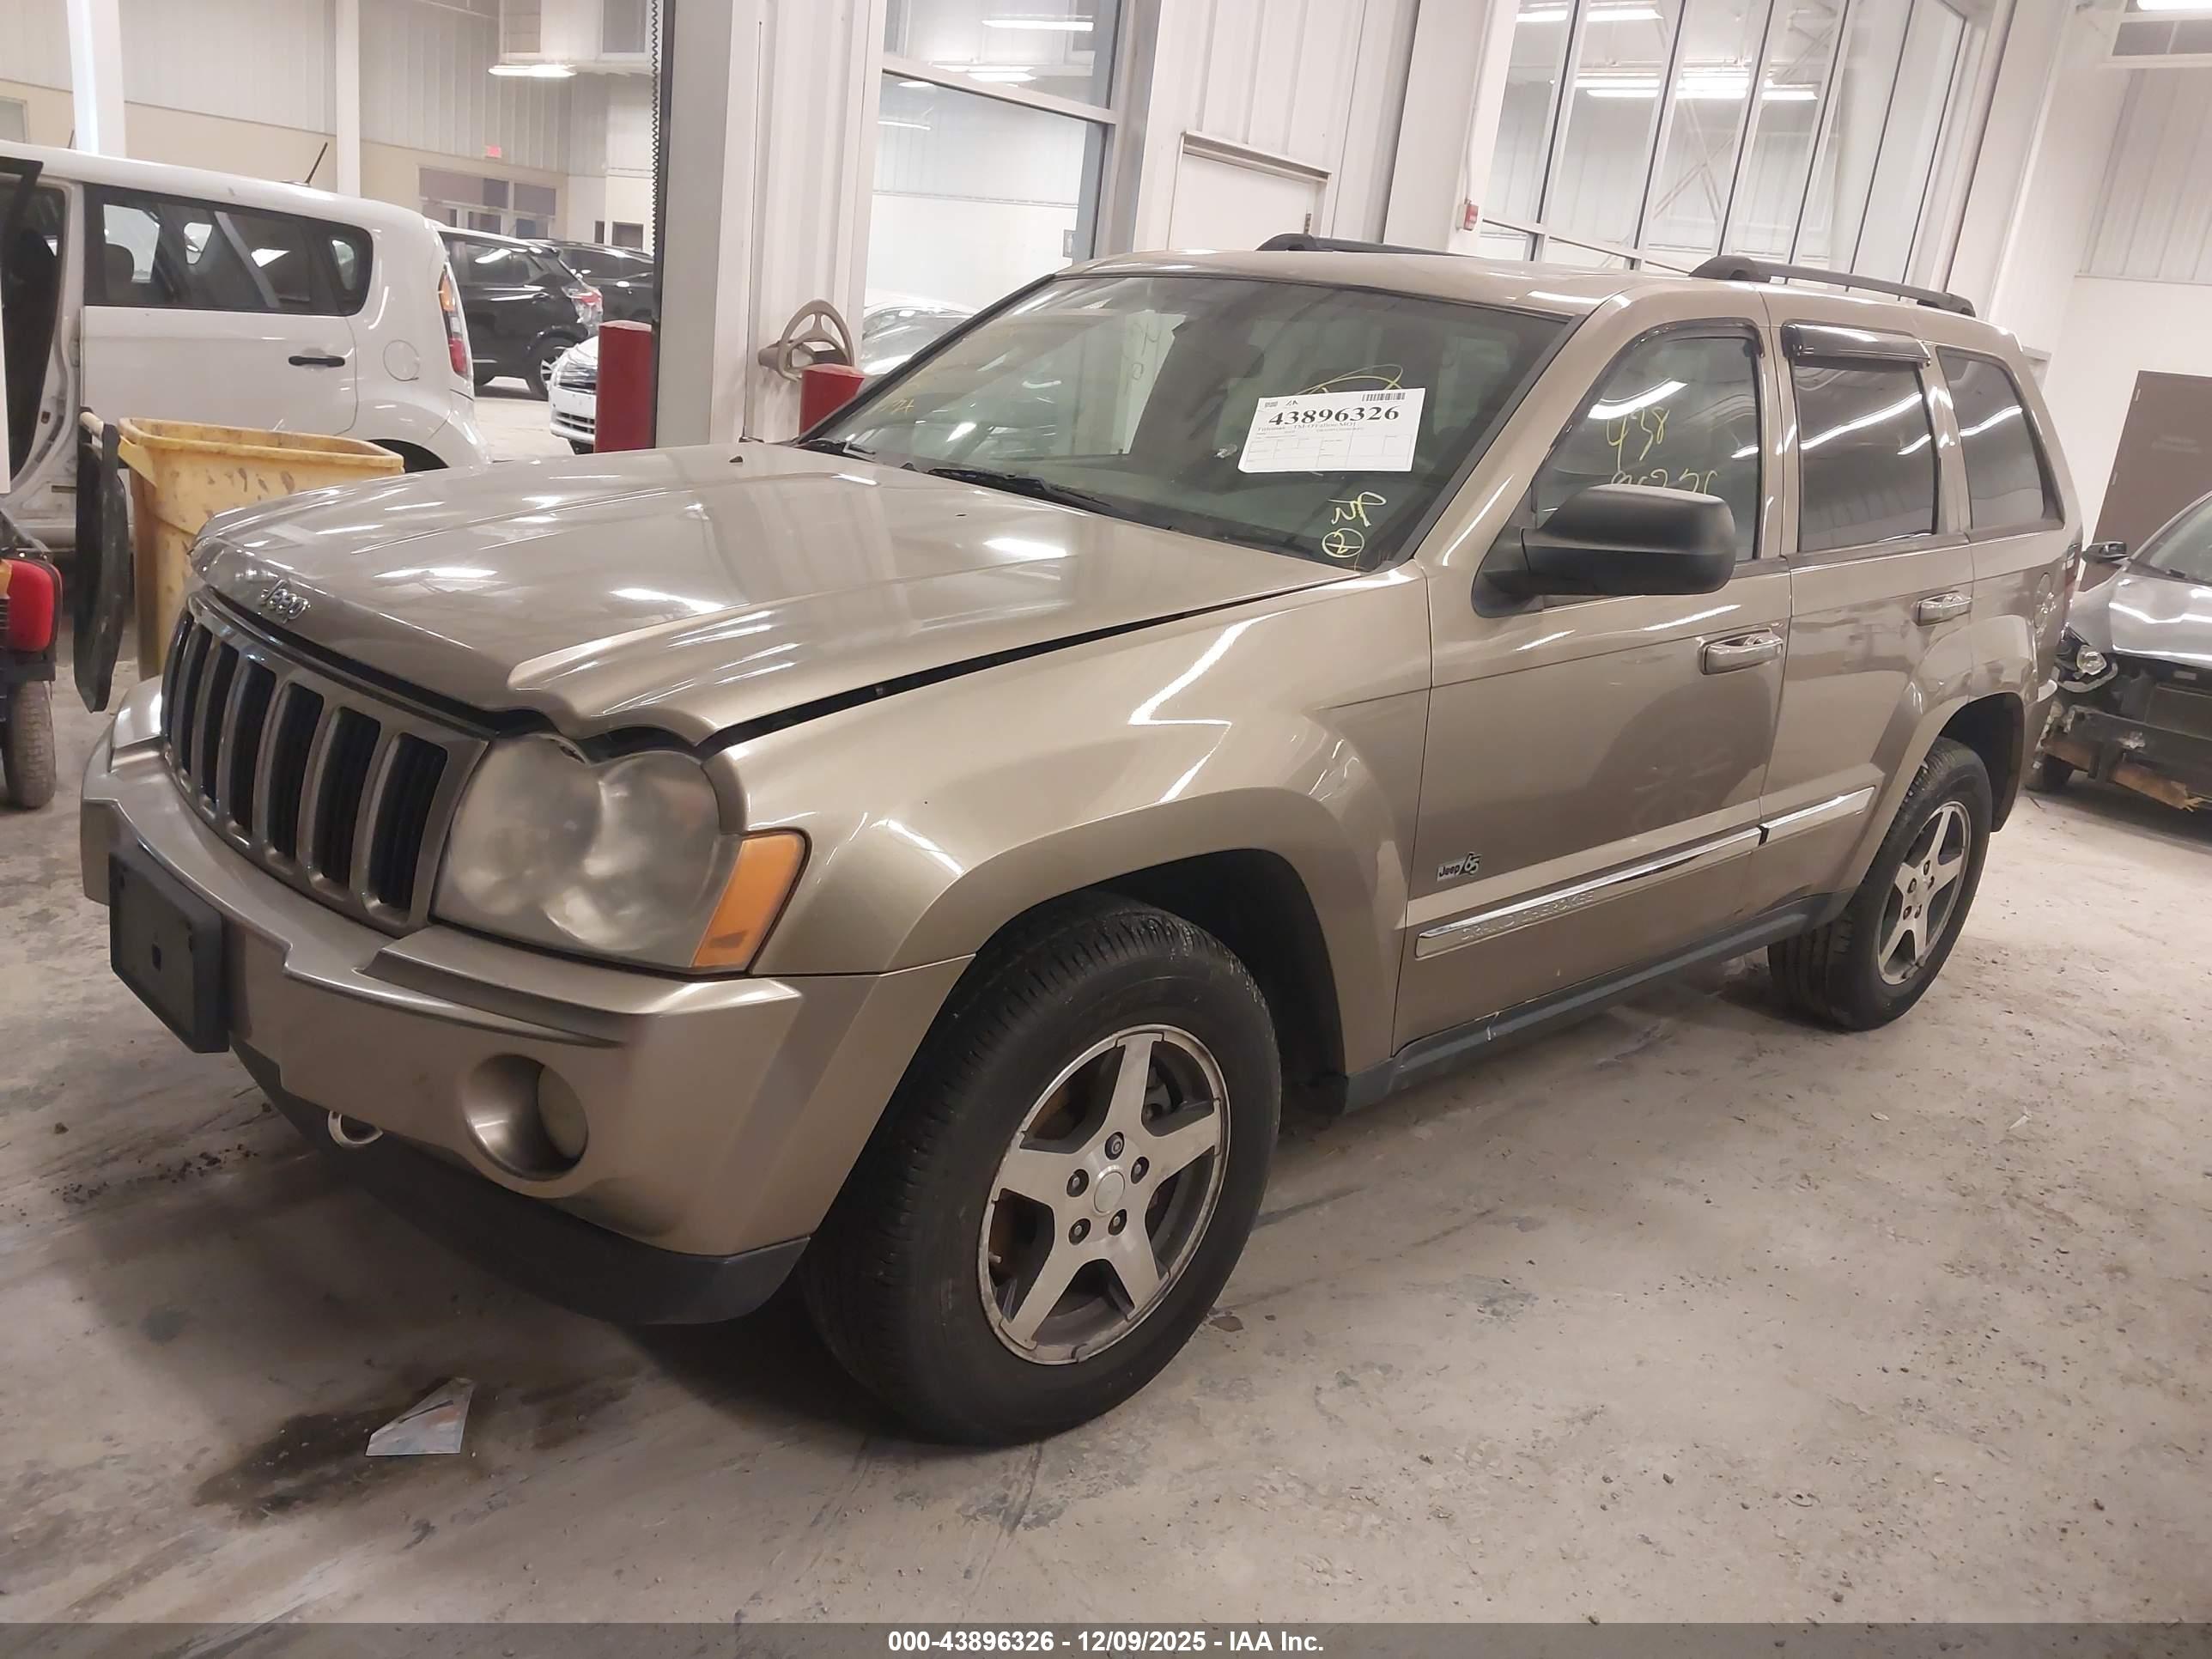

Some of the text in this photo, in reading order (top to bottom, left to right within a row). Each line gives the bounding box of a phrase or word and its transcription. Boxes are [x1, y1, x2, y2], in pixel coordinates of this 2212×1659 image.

[1268, 405, 1400, 426] 43896326
[1606, 407, 1669, 471] 438
[258, 579, 310, 624] Jeep
[1439, 851, 1483, 877] Jeep 65
